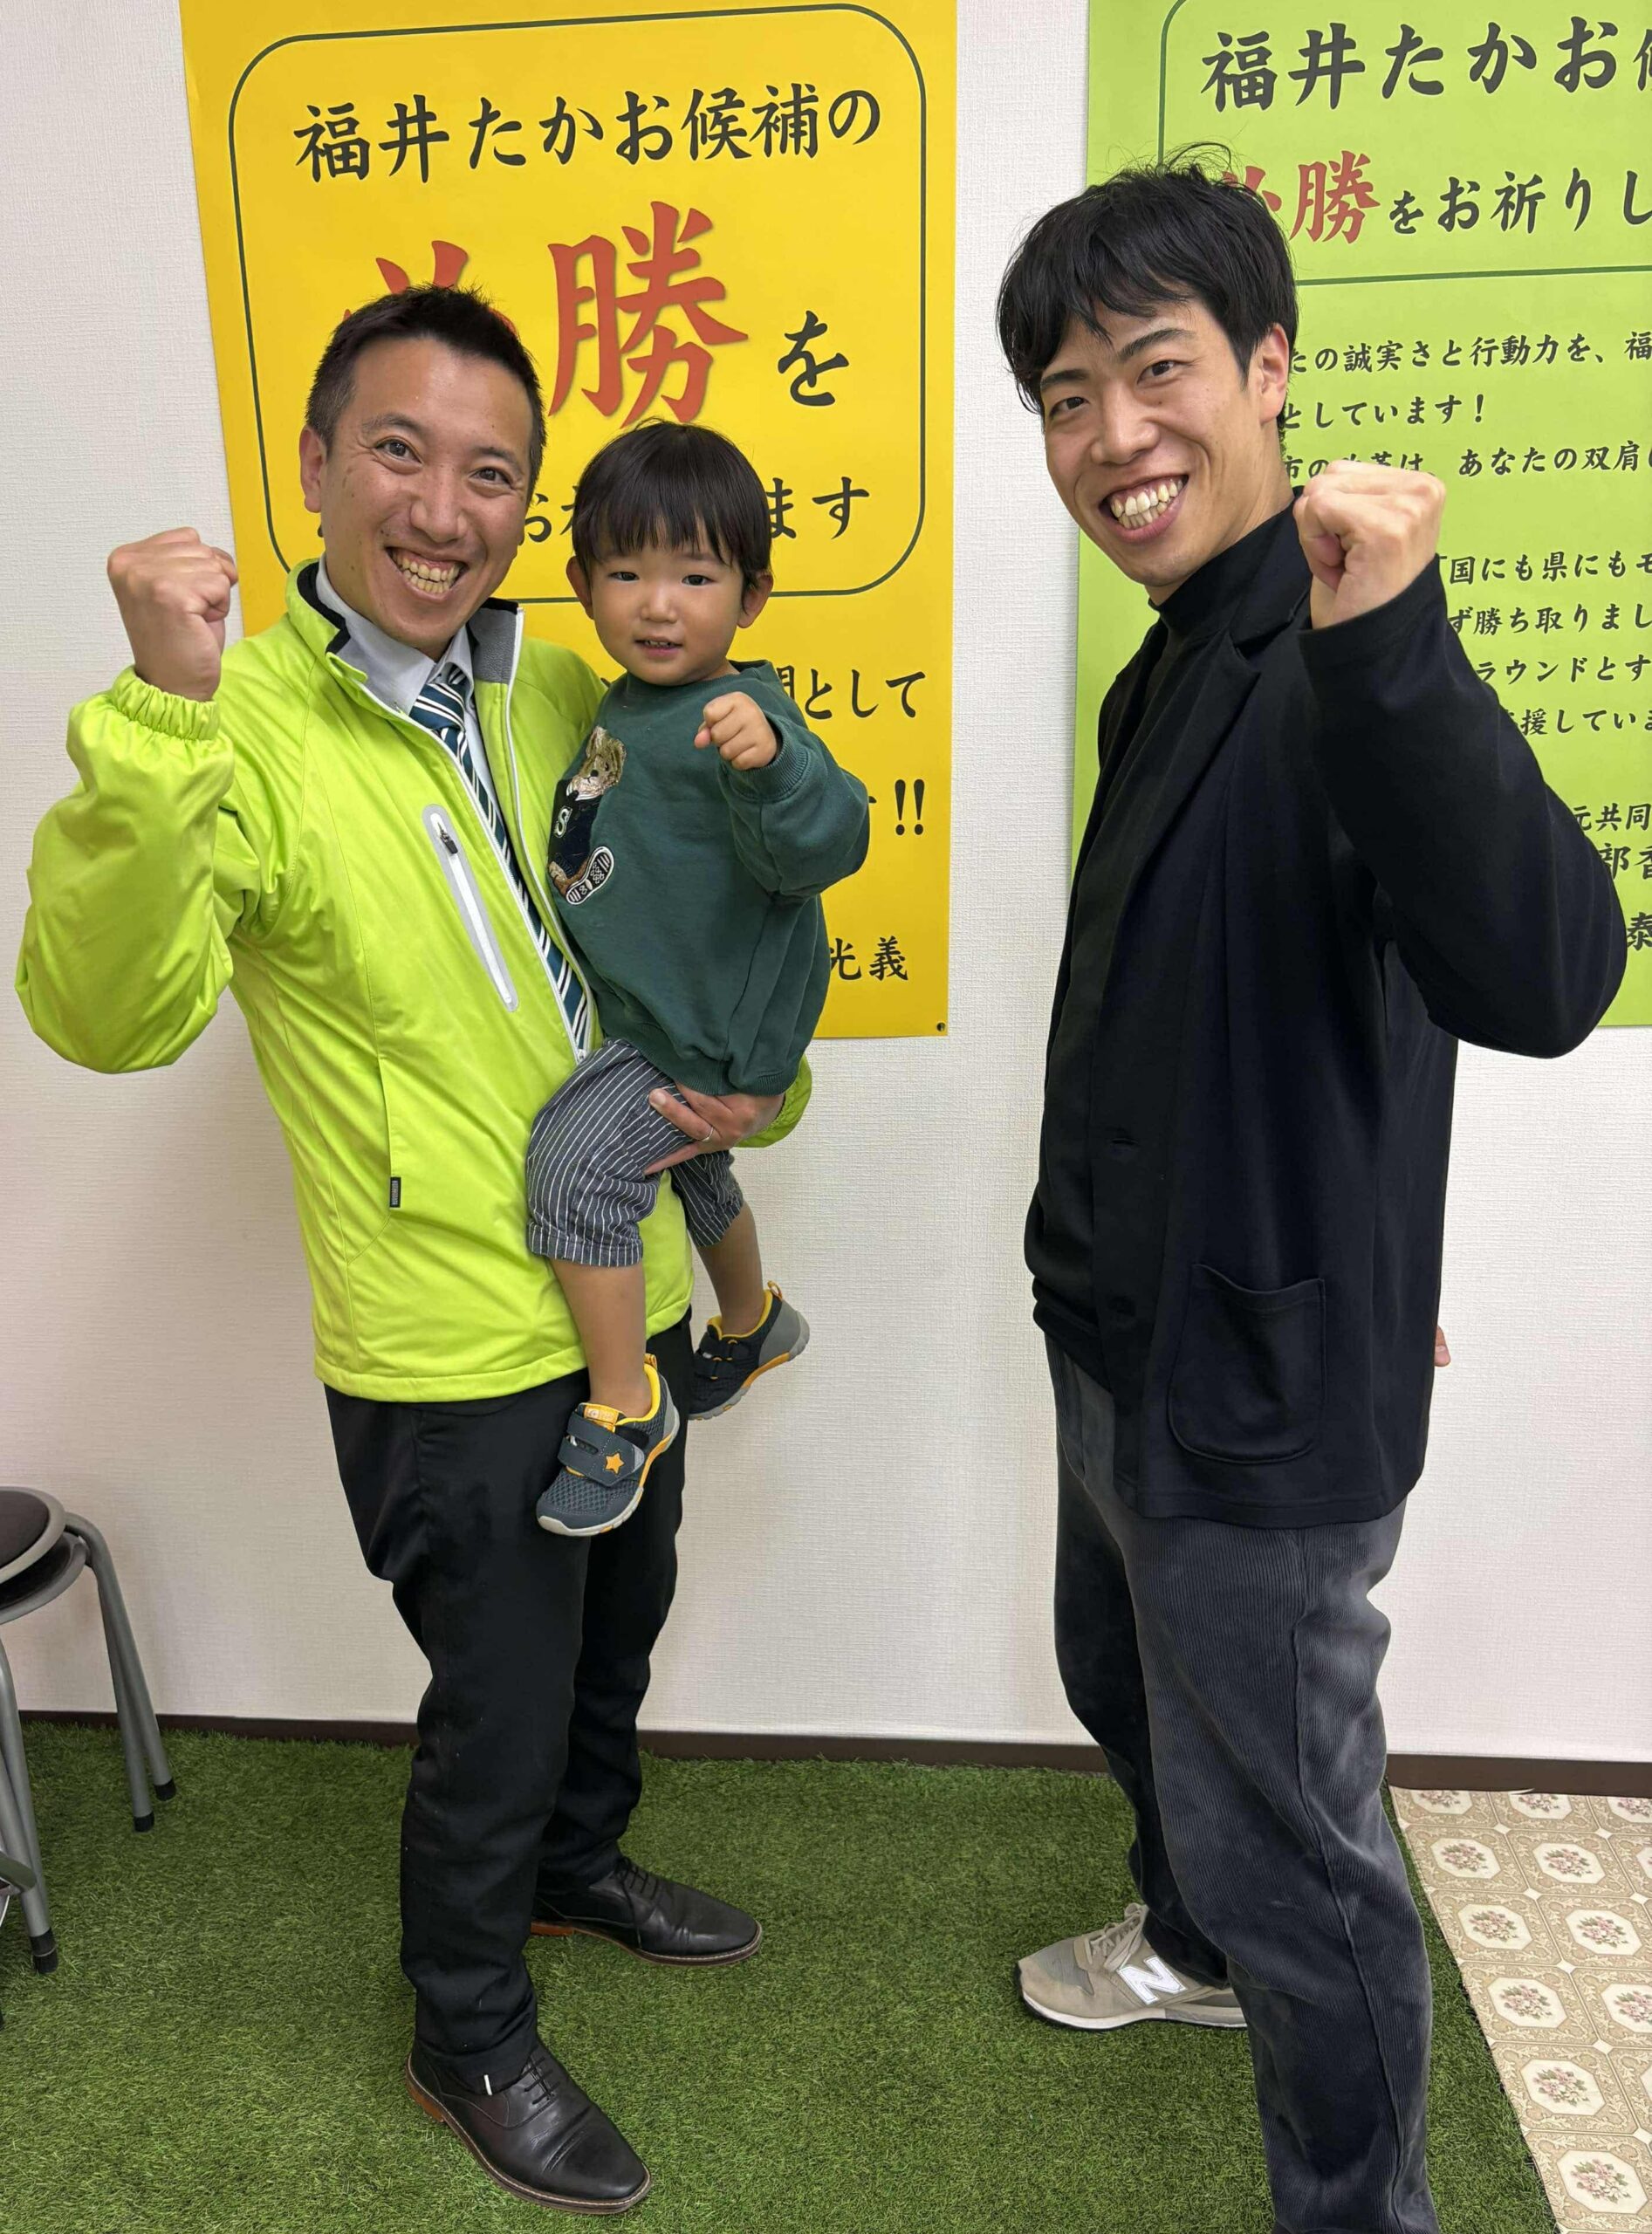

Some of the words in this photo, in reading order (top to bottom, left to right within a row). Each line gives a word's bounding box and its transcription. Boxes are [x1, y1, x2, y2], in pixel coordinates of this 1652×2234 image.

[293, 83, 881, 184] 福井たかお候補の
[345, 201, 850, 428] 勝を
